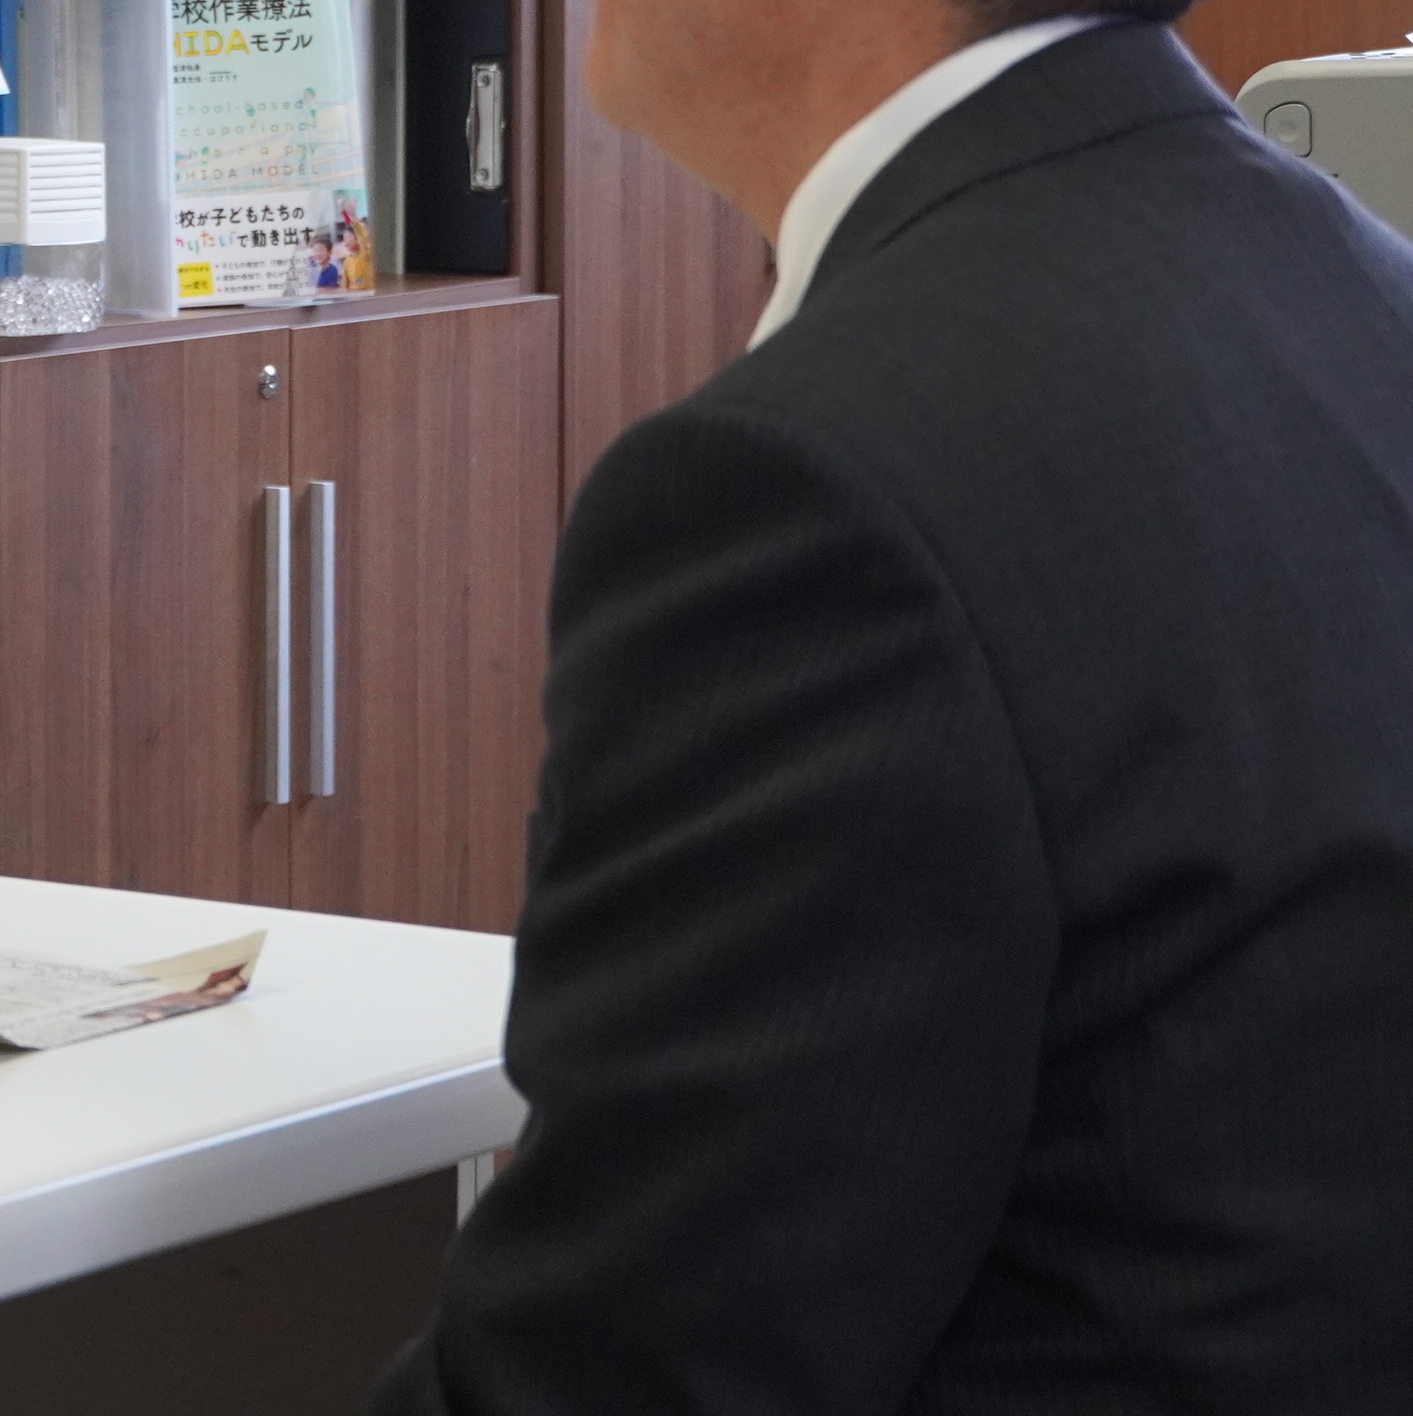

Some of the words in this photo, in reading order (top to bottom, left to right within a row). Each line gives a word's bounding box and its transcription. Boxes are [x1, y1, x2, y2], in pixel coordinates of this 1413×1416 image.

[175, 99, 304, 116] chool-based
[175, 206, 305, 229] 校が子どもたちの
